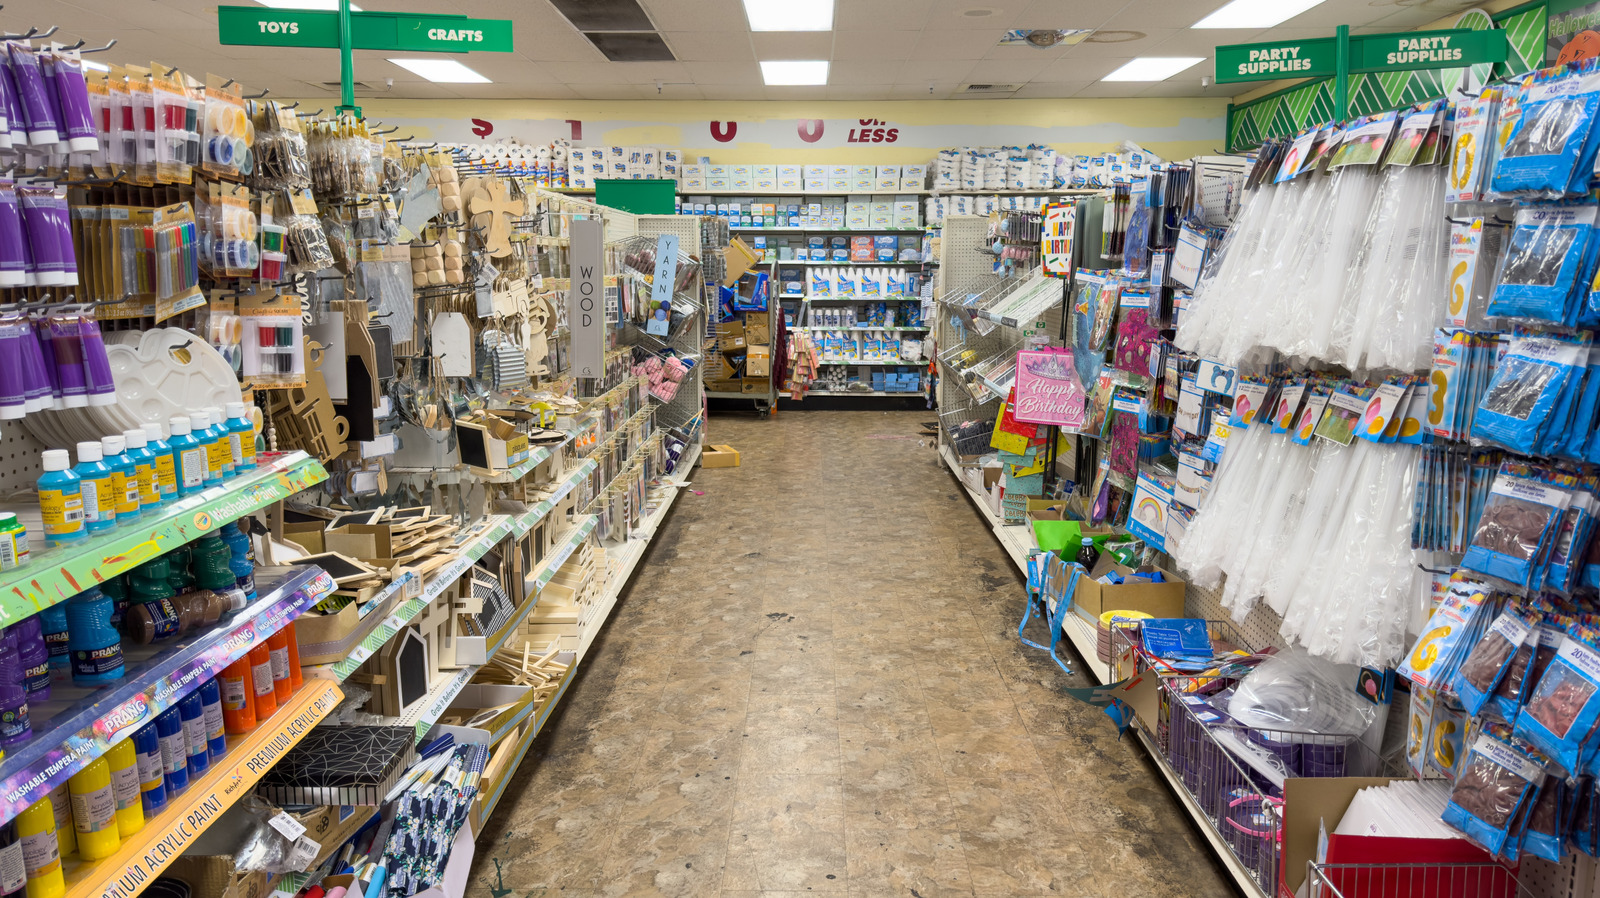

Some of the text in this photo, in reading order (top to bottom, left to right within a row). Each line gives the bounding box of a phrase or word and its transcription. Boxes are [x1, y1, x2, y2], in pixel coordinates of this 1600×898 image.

[258, 21, 299, 34] TOYS
[428, 29, 484, 42] CRAFTS
[1250, 47, 1300, 62] PARTY
[1398, 36, 1451, 51] PARTY
[1238, 58, 1312, 75] SUPPLIES
[1387, 48, 1462, 64] SUPPLIES
[848, 128, 899, 143] LESS
[1052, 222, 1072, 237] HAPPY
[659, 240, 671, 294] YARN
[580, 265, 594, 327] WOOD
[1026, 378, 1076, 400] Happy
[1019, 396, 1084, 420] Birthday
[208, 494, 256, 522] Washable
[307, 576, 331, 597] PRANG
[161, 598, 178, 622] PRANG
[92, 644, 120, 658] PRANG
[222, 629, 253, 652] PRANG
[154, 656, 217, 702] WASHABLE TEMPERA PAINT
[104, 701, 147, 733] PRANG
[246, 732, 292, 775] PREMIUM
[286, 706, 320, 738] ACRYLIC
[314, 688, 338, 713] PAINT
[6, 738, 96, 804] WASHABLE TEMPERA PAINT
[144, 822, 192, 872] ACRYLIC
[187, 793, 223, 830] PAINT
